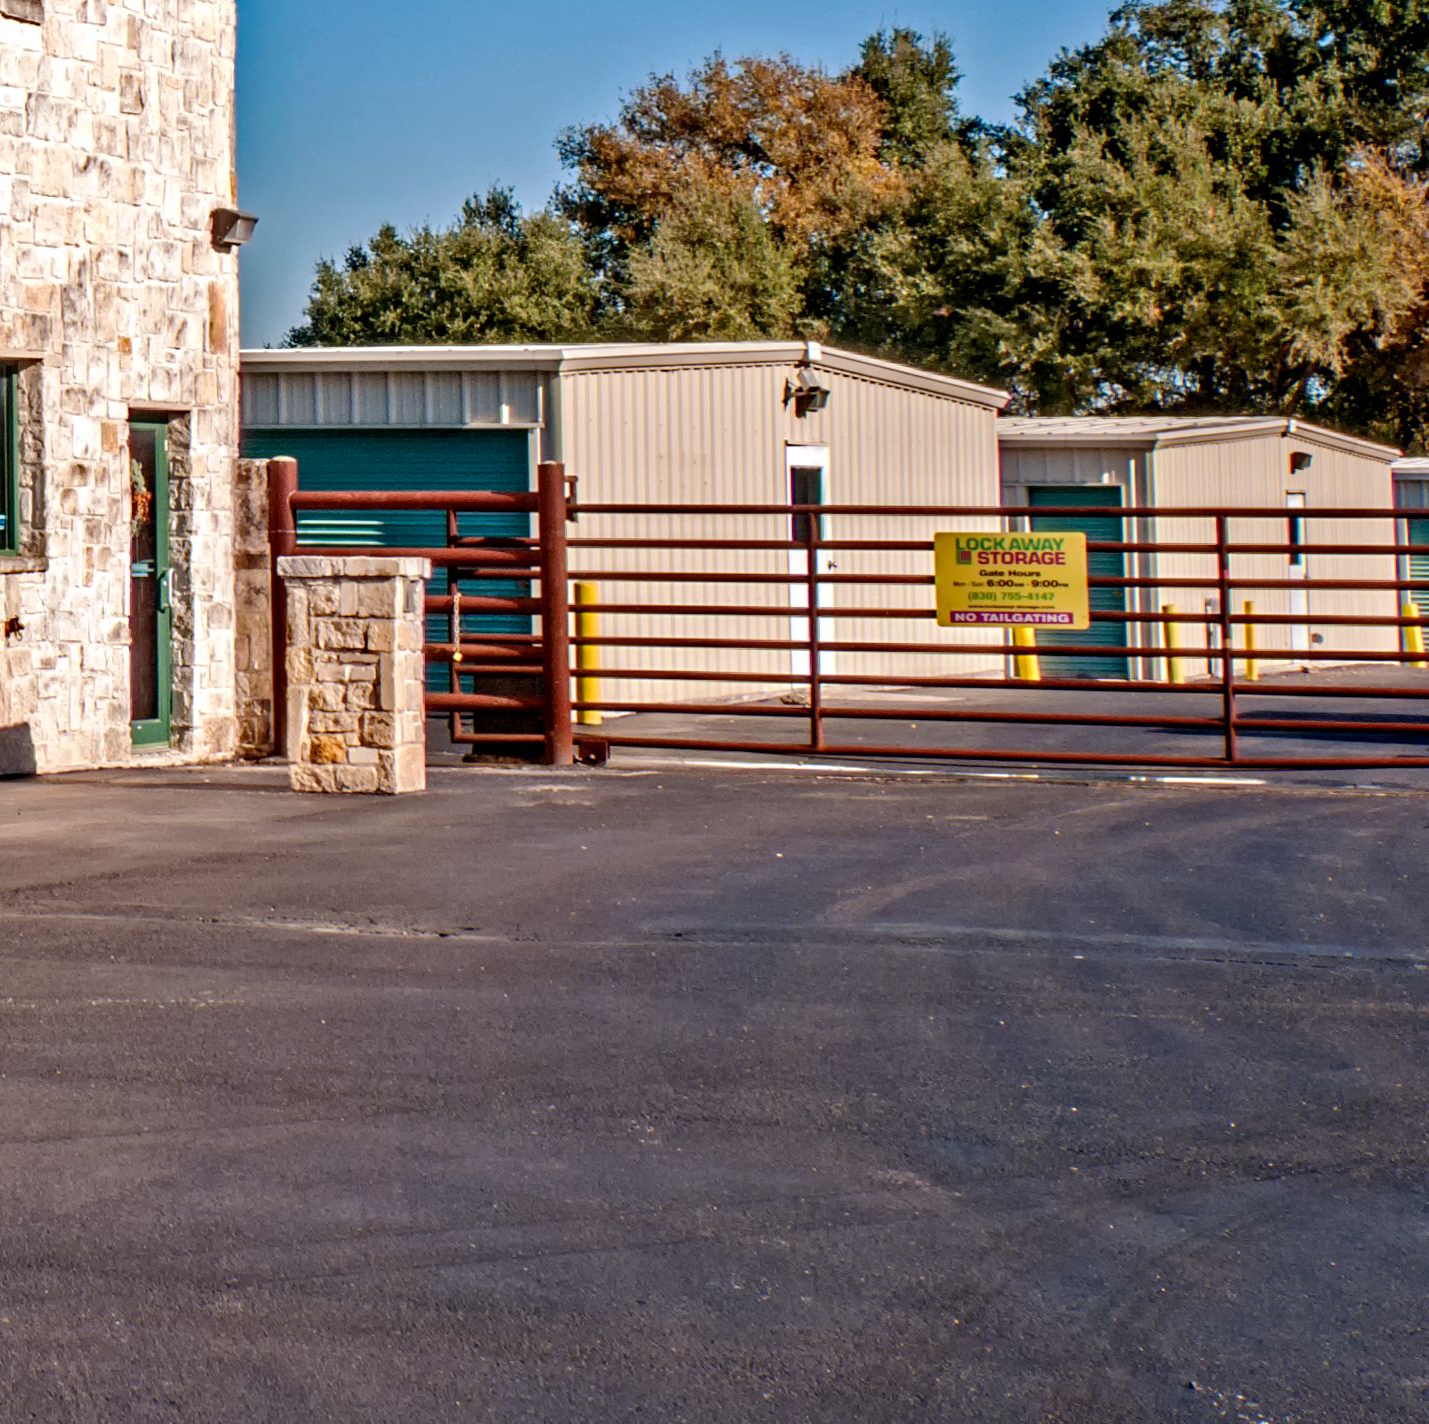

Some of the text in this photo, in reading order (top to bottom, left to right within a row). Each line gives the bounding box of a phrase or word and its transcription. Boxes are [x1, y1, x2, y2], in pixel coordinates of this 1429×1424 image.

[977, 552, 1066, 565] STORAGE
[979, 569, 1041, 577] Gate Hours
[954, 613, 1070, 623] NO TAILGATING
